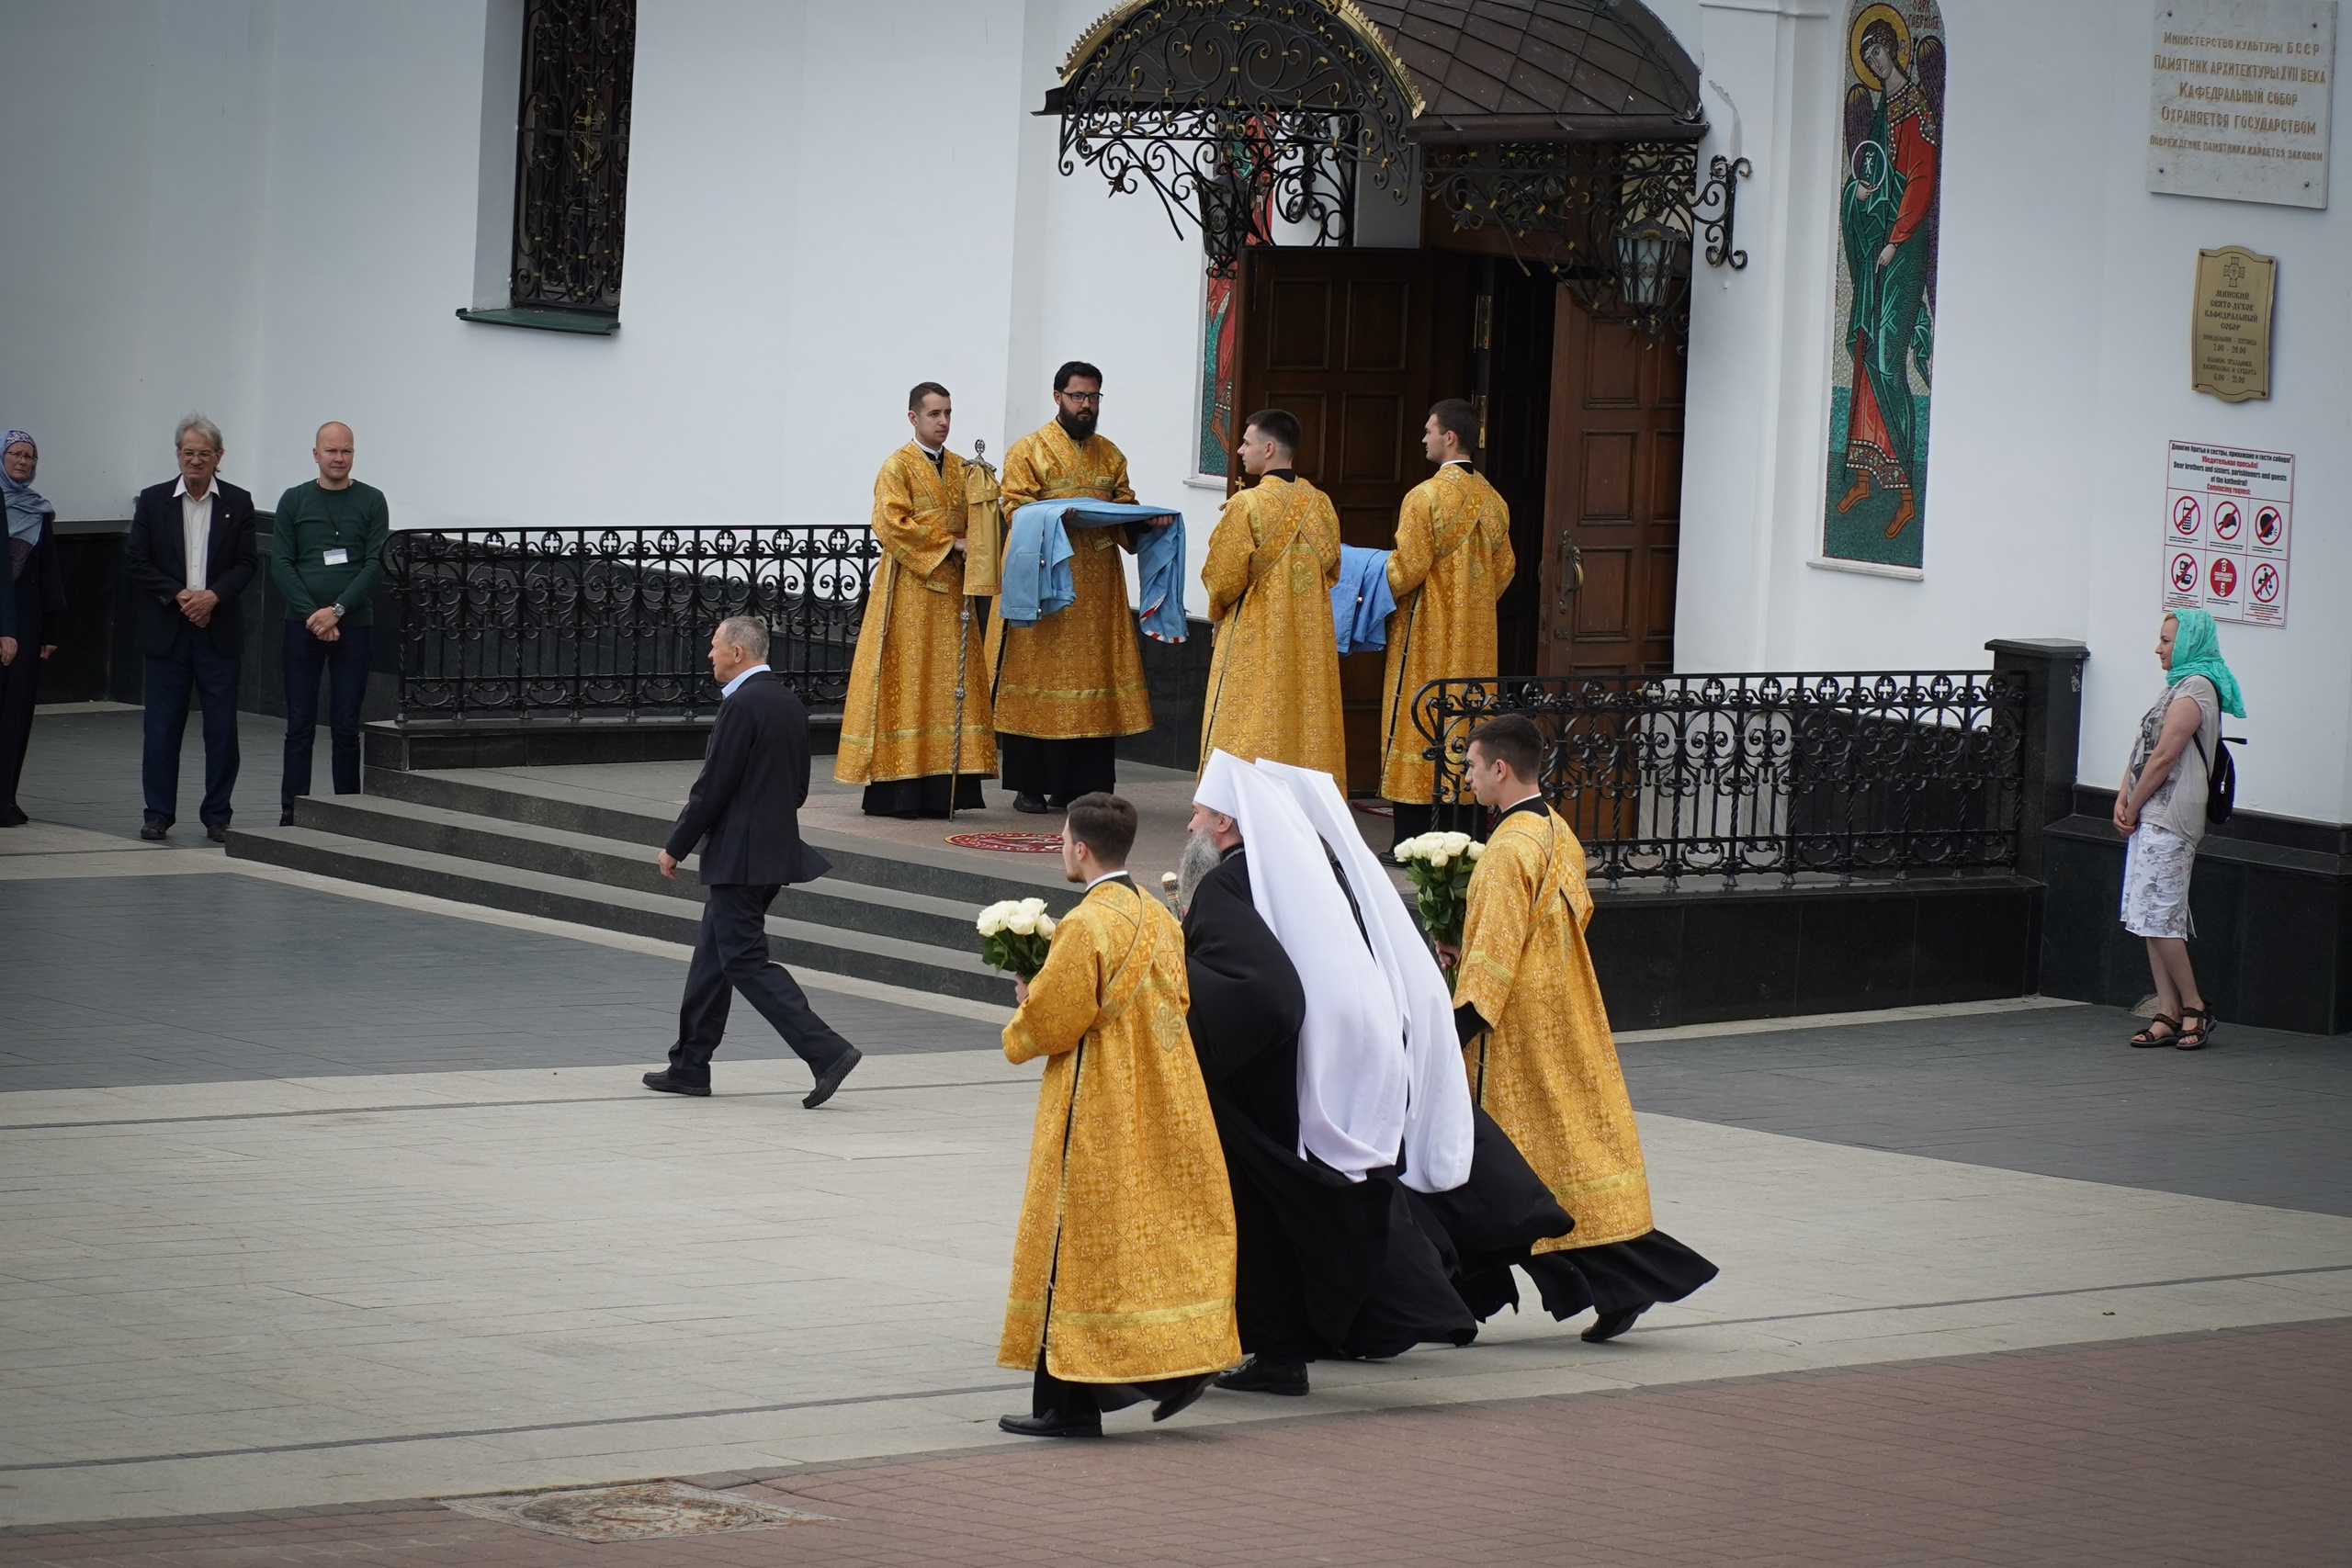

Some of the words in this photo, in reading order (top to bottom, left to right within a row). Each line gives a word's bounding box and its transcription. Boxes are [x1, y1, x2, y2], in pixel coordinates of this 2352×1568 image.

[2210, 62, 2278, 80] АРХИТЕКТУРЫ
[2301, 69, 2326, 85] ВЕКА
[2267, 92, 2298, 107] СОБОР
[2233, 115, 2316, 135] ГОСУДАРСТВОМ
[2215, 289, 2249, 300] МИНСКИЙ
[2204, 310, 2258, 322] КАФЕДРАЛЬНЫЙ
[2221, 322, 2241, 331] СОБОР
